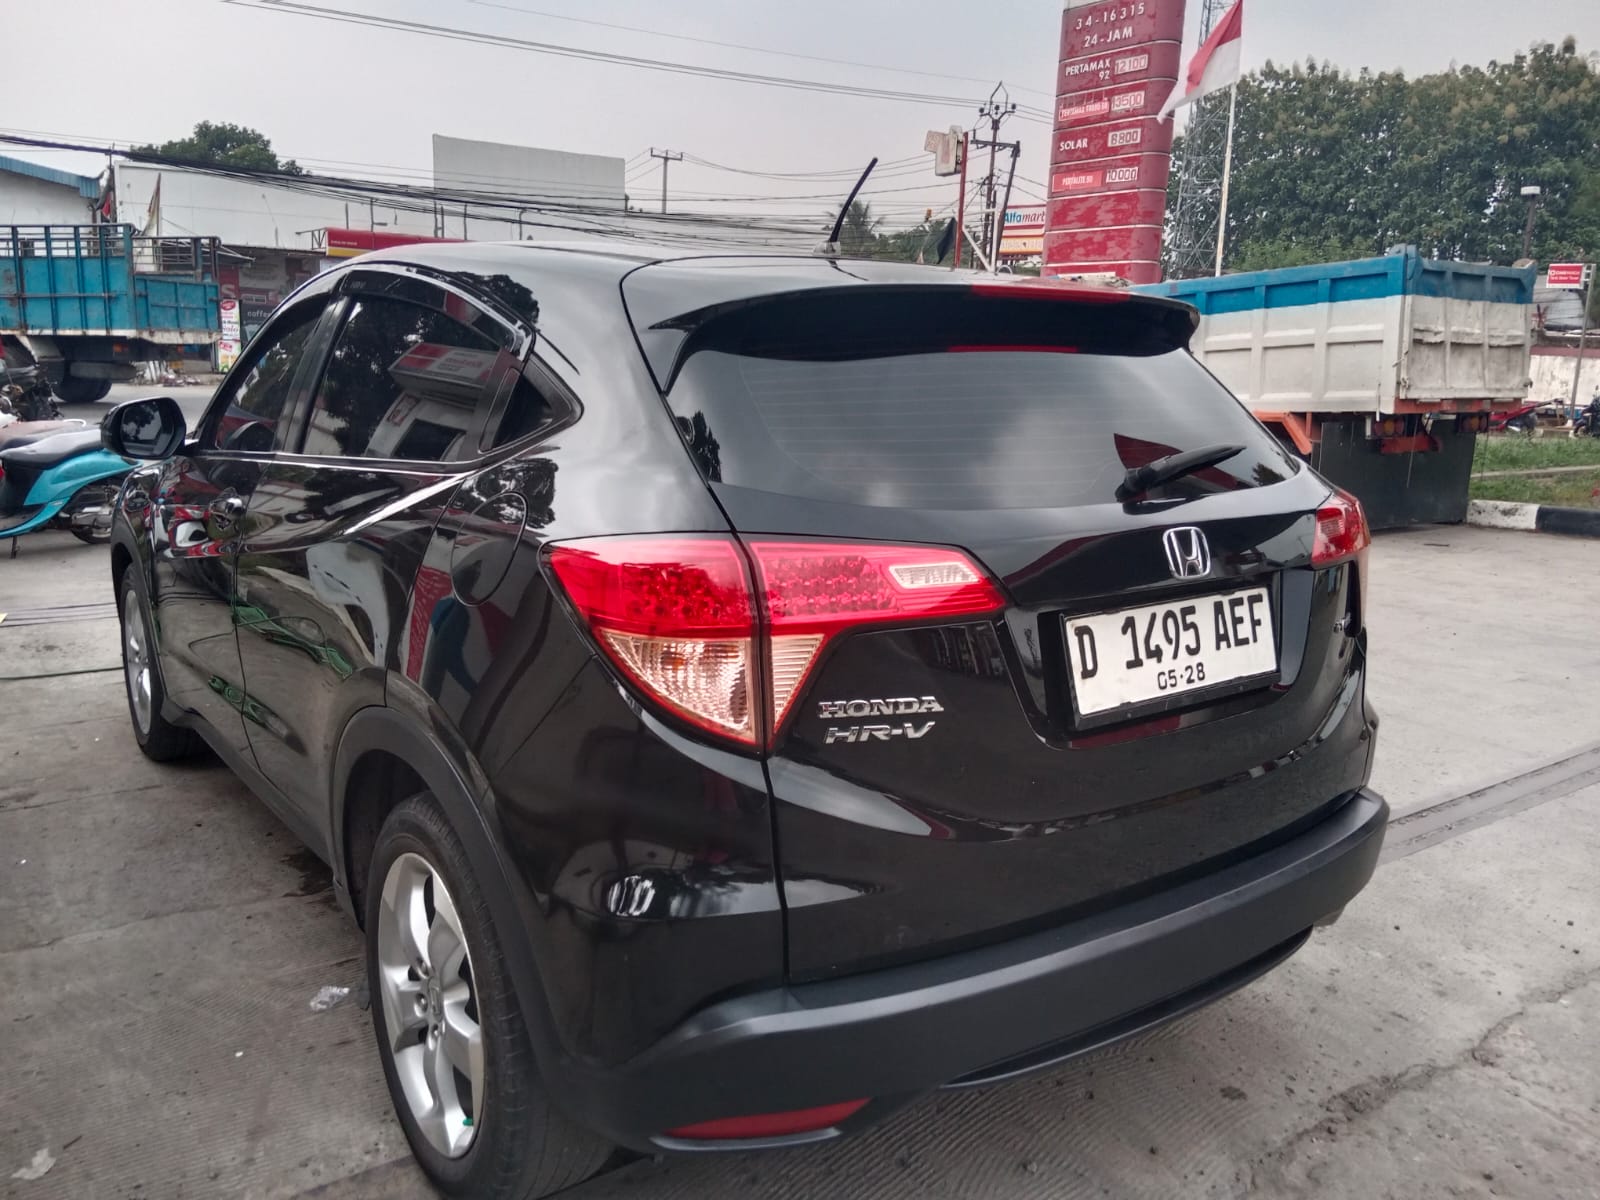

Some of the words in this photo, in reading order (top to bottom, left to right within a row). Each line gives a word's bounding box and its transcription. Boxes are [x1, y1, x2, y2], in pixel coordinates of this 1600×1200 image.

[1075, 2, 1145, 30] 34-16315
[1083, 26, 1133, 48] 24-JAM
[1065, 58, 1111, 76] PERTAMAX
[1099, 70, 1110, 81] 92
[1060, 138, 1088, 152] SOLAR
[1004, 211, 1045, 223] Alfamart
[1074, 625, 1098, 680] D
[1121, 605, 1201, 670] 1495
[1213, 594, 1264, 651] AEF
[818, 695, 944, 719] HONDA
[824, 721, 936, 744] HR-V
